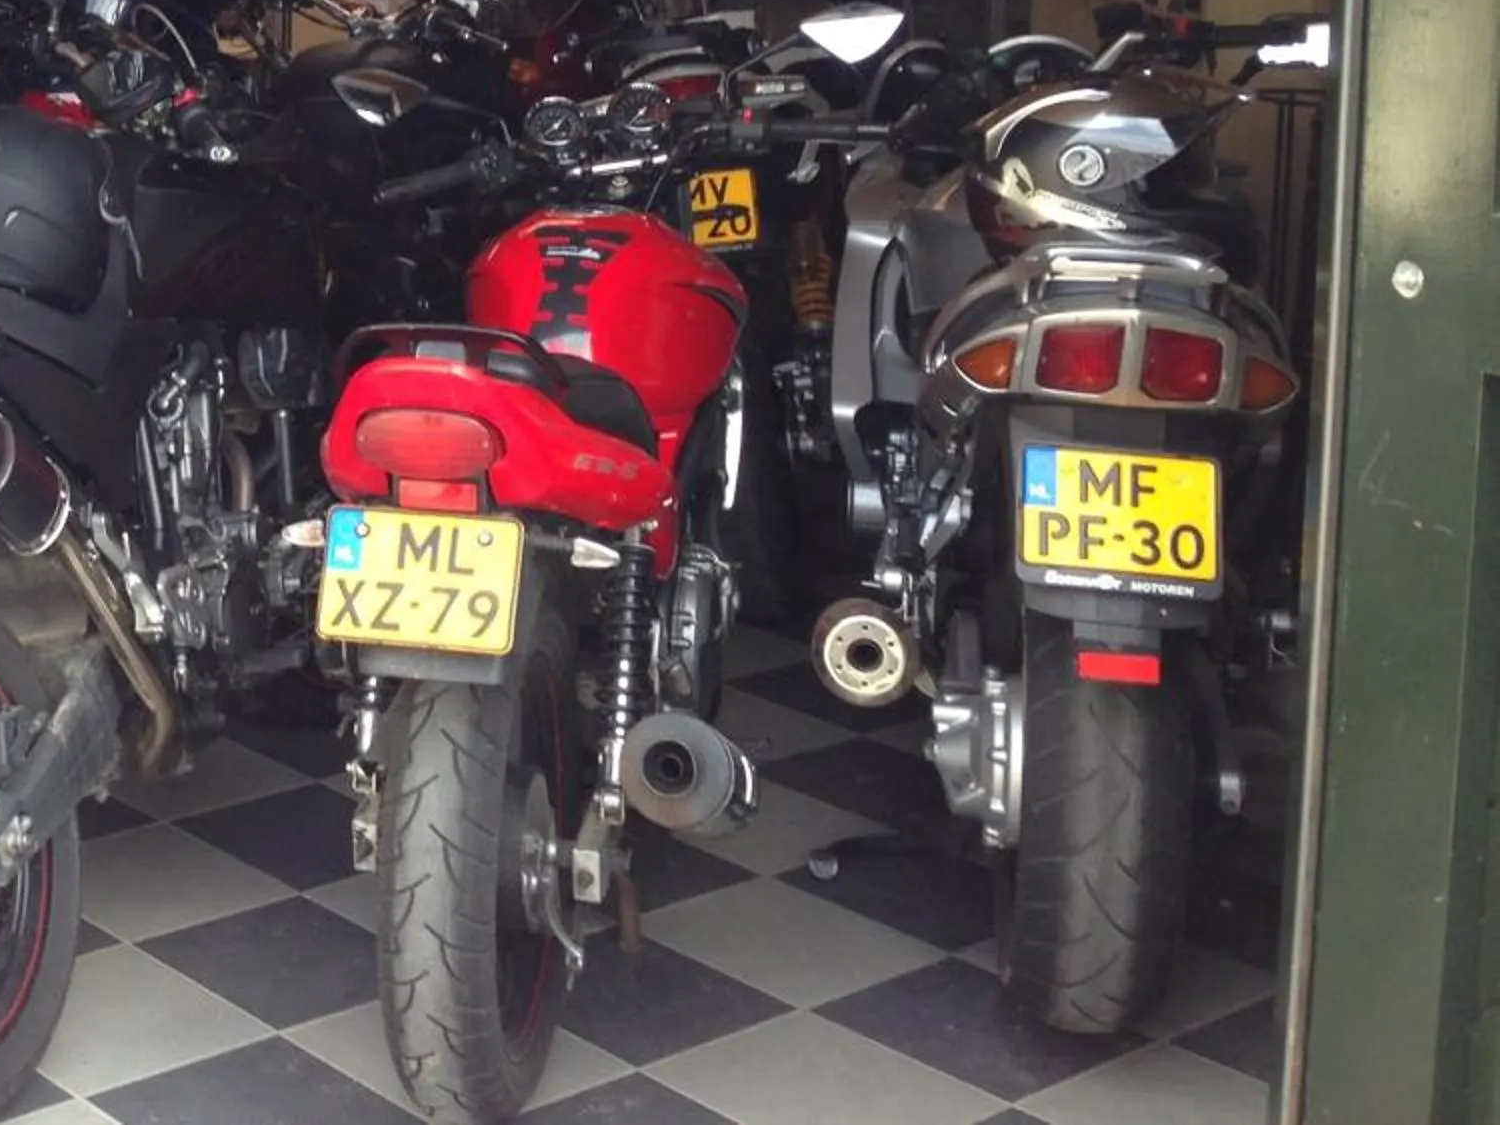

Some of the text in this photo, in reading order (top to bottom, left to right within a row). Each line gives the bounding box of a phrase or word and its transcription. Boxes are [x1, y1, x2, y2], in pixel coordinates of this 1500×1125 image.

[1078, 459, 1159, 508] MF
[397, 522, 475, 576] ML
[1038, 511, 1206, 570] PF-30
[330, 578, 500, 639] XZ-79
[1130, 579, 1196, 598] MOTOREN
